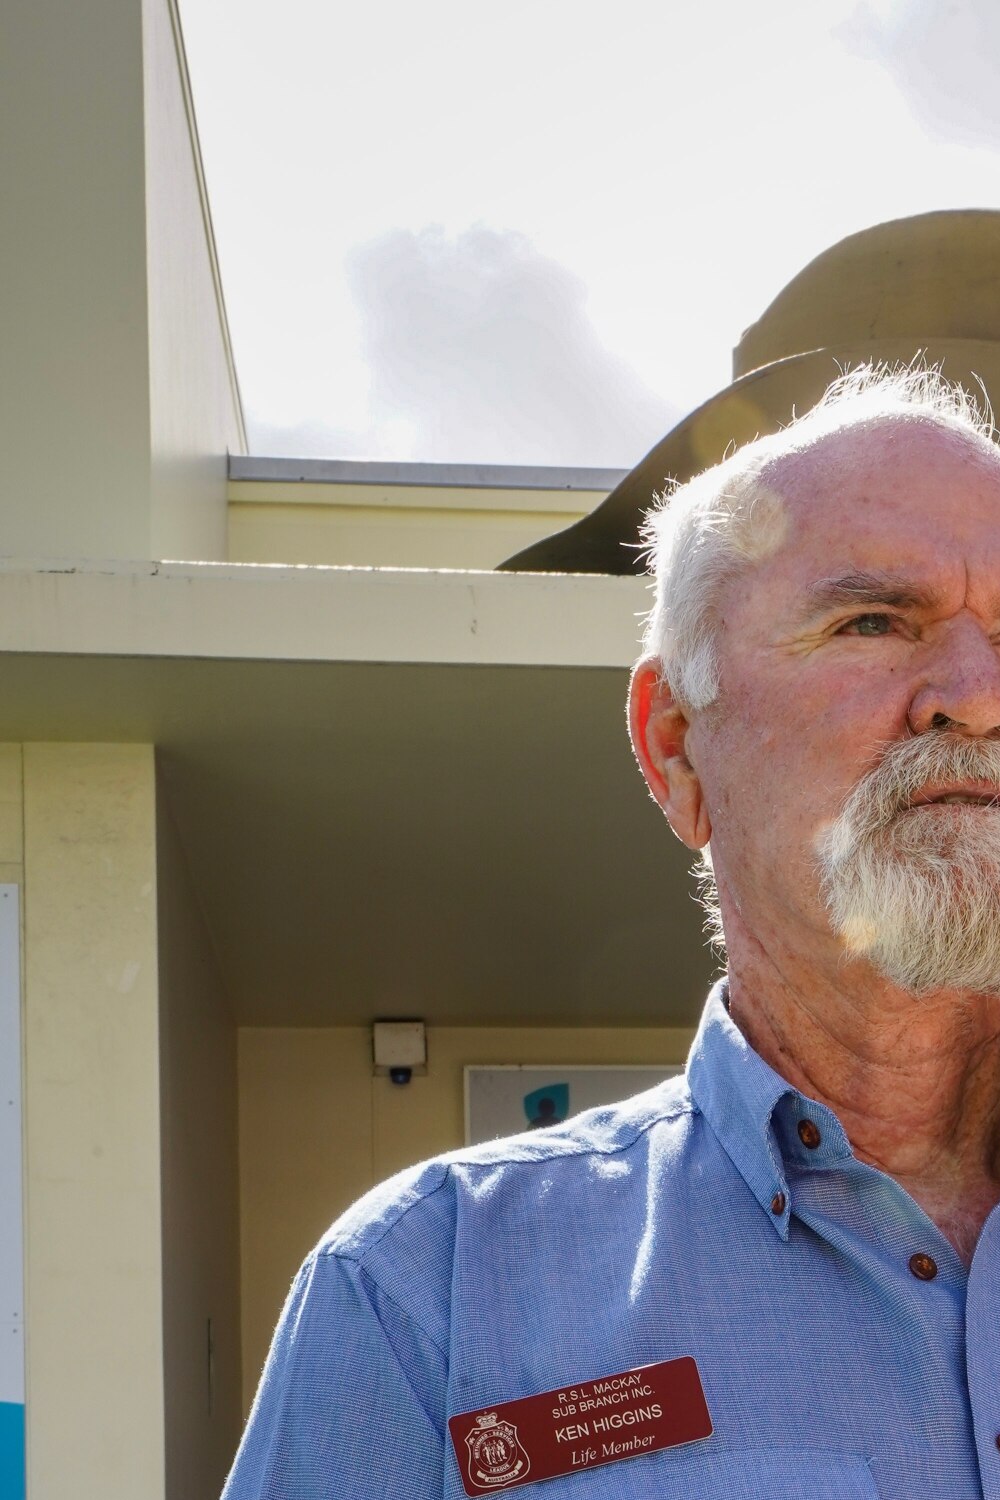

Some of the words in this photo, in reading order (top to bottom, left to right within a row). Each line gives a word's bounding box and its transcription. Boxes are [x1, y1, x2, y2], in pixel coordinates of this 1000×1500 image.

[552, 1404, 577, 1419] SUB
[579, 1391, 629, 1412] BRANCH
[631, 1384, 656, 1399] INC.
[558, 1388, 591, 1404] R.S.L.
[593, 1373, 642, 1395] MACKAY
[555, 1422, 590, 1443] KEN
[593, 1404, 663, 1433] HIGGINS
[571, 1448, 597, 1466] Life
[601, 1434, 656, 1458] Member
